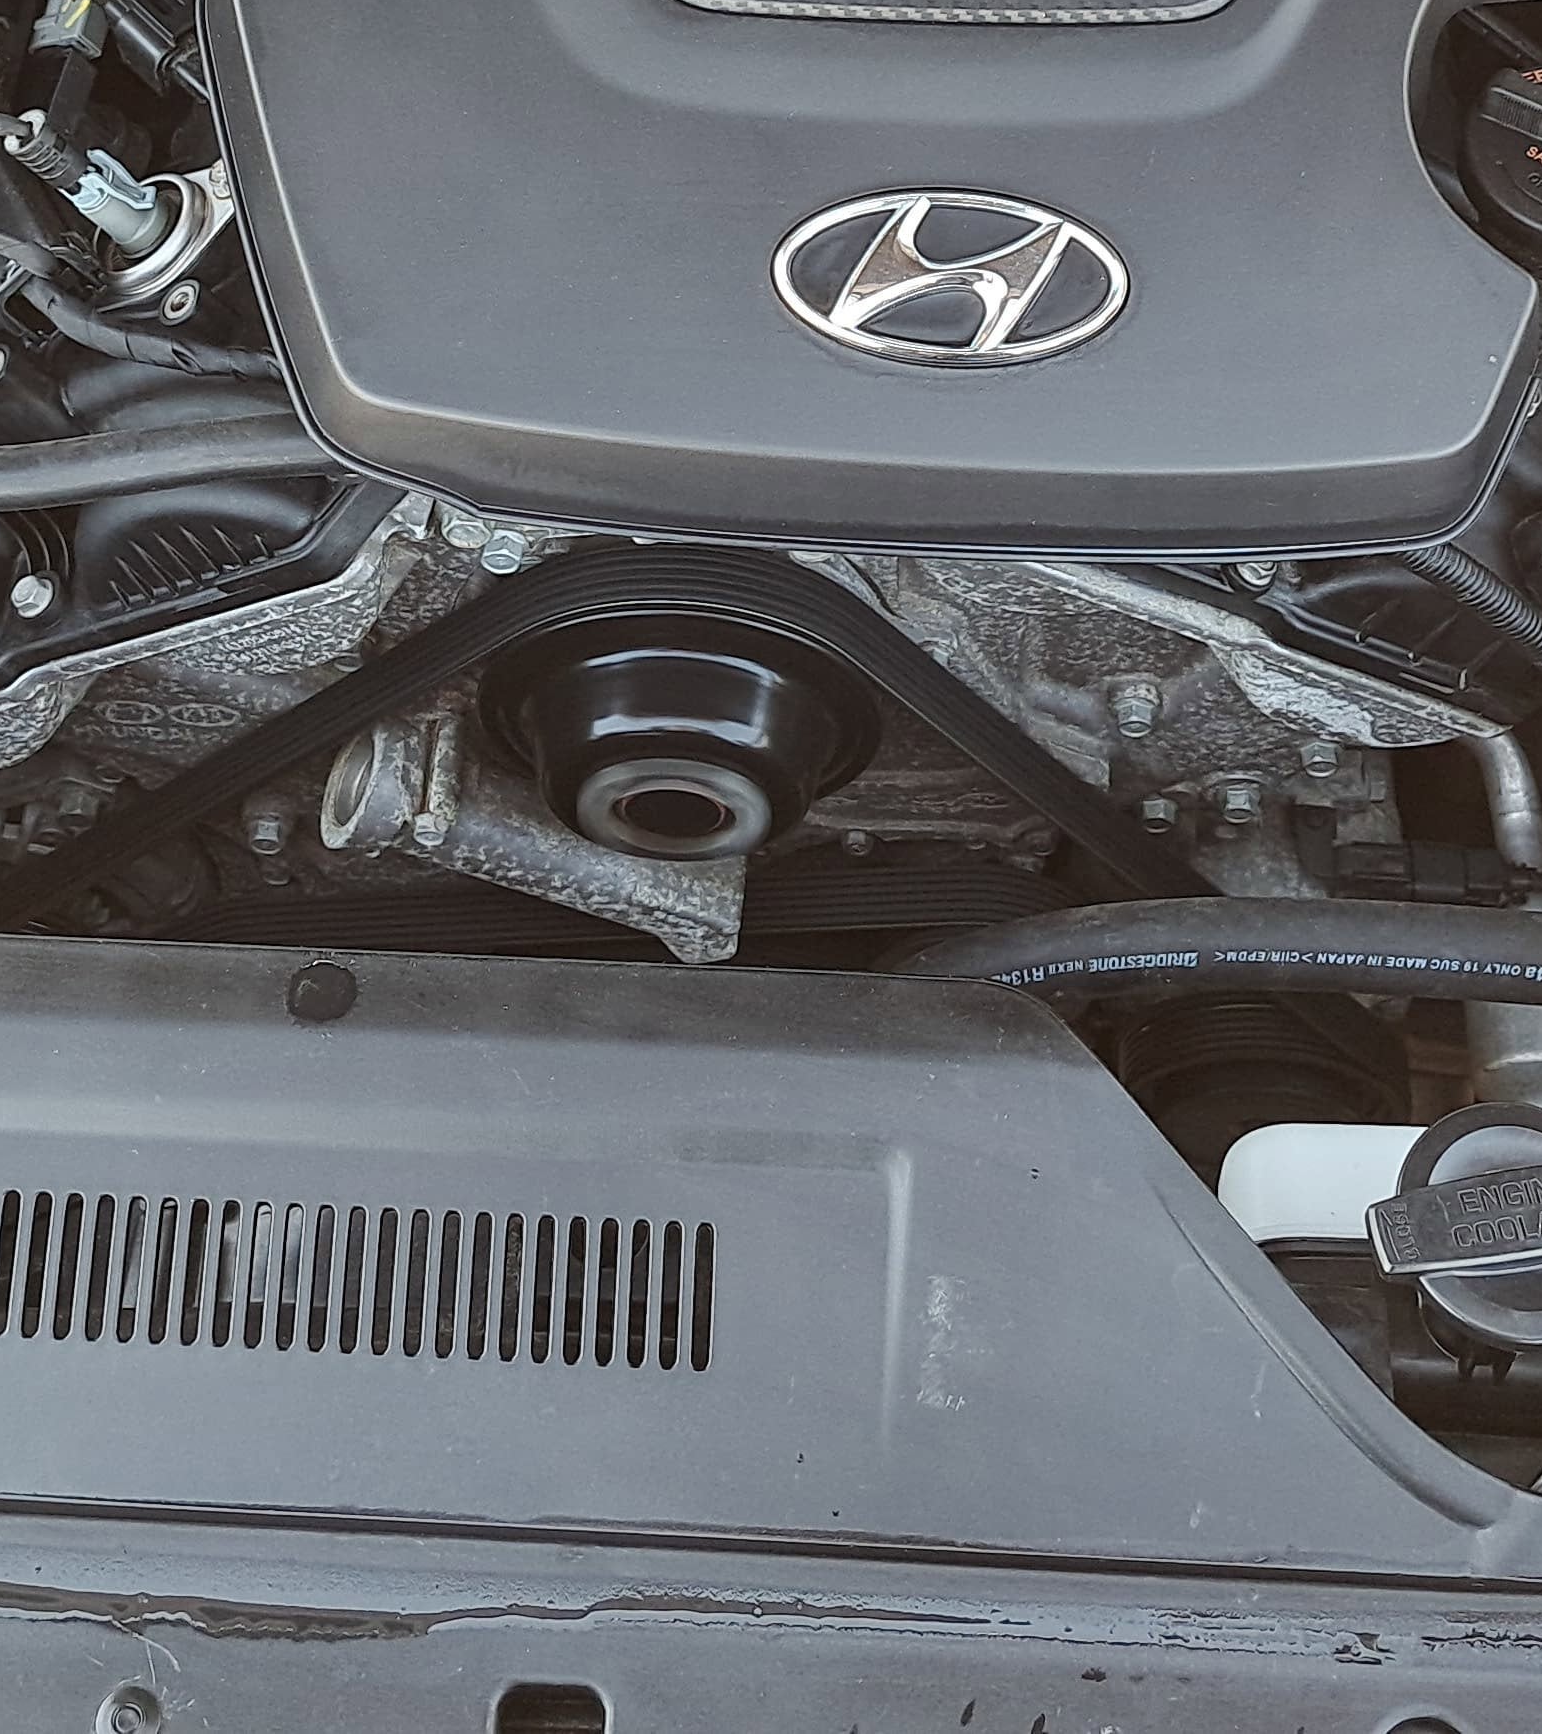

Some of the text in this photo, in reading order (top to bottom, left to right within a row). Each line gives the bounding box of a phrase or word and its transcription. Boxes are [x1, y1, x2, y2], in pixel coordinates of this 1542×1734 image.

[1088, 951, 1199, 973] BRIDGESTONE
[1316, 951, 1364, 966] JAPAN
[1367, 954, 1383, 968] IN
[1386, 955, 1428, 969] MADE
[1463, 960, 1479, 973] 19
[1482, 962, 1521, 977] ONLY
[991, 967, 1045, 986] R134
